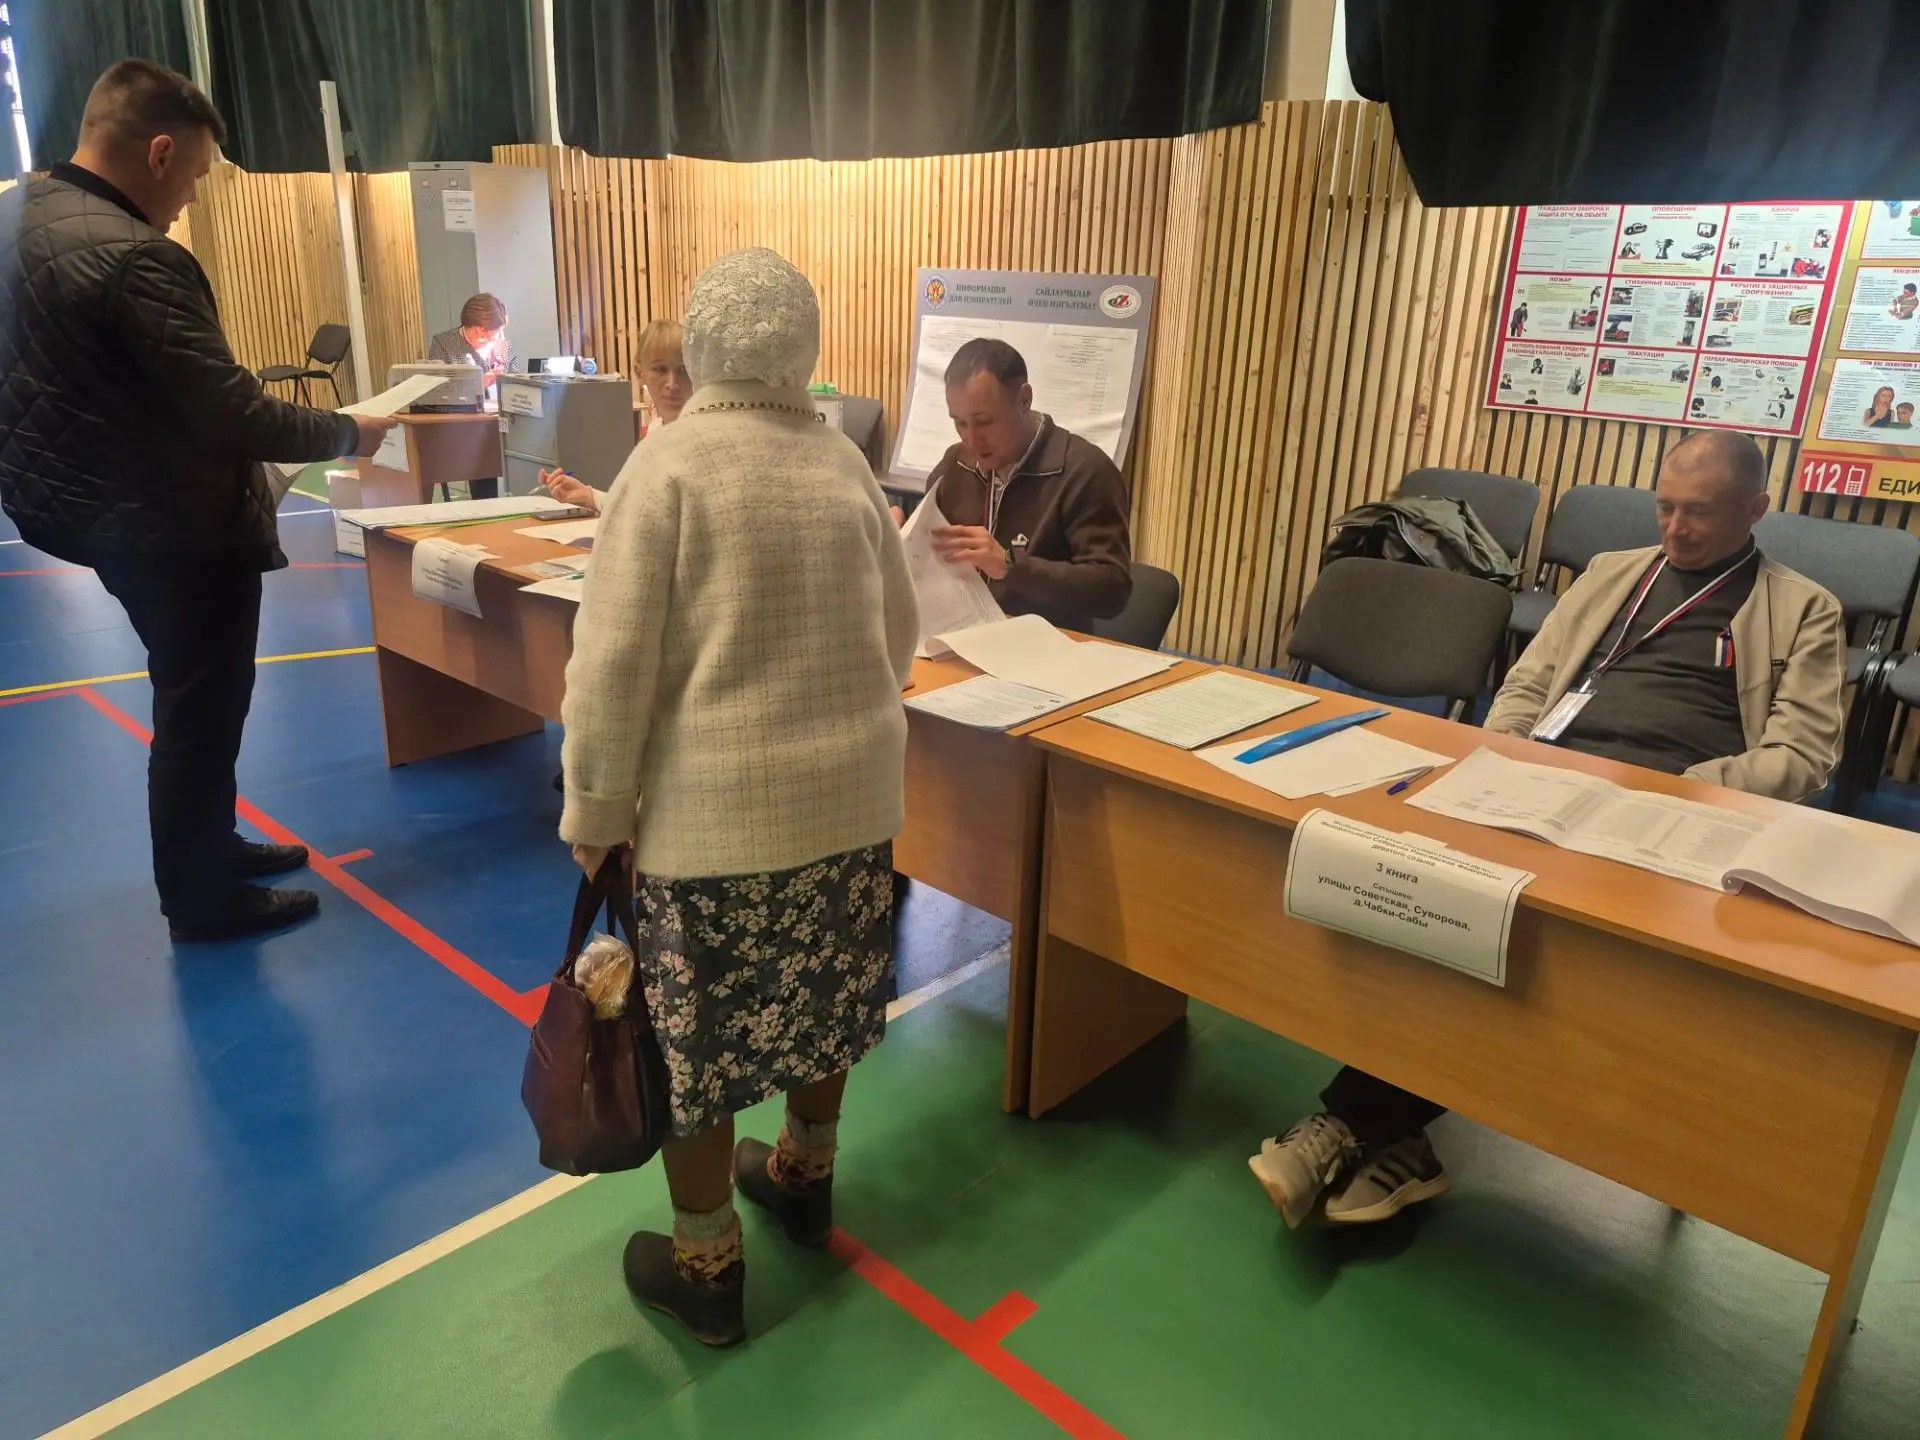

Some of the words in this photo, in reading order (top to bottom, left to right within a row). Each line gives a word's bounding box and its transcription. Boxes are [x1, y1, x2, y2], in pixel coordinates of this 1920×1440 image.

[956, 284, 1006, 294] ИНФОРМАЦИЯ
[1035, 286, 1092, 298] САЙЛАУЧЫЛАР
[949, 295, 962, 304] ДЛЯ
[963, 295, 1012, 305] ИЗБИРАТЕЛЕЙ
[1627, 350, 1665, 358] ЭВАКУАЦИЯ
[1726, 357, 1770, 366] МЕДИЦИНСКАЯ
[1770, 360, 1799, 368] ПОМОЩЬ
[1803, 461, 1842, 493] 112
[1878, 477, 1920, 496] ЕДИ
[1371, 843, 1406, 858] девятого
[1406, 854, 1436, 868] созыва
[1376, 862, 1384, 873] 3
[1386, 865, 1419, 884] книга
[1318, 874, 1351, 892] улицы
[1353, 885, 1411, 912] Советская,
[1413, 905, 1471, 932] Суворова,
[1353, 899, 1429, 929] д.Чабки-Сабы
